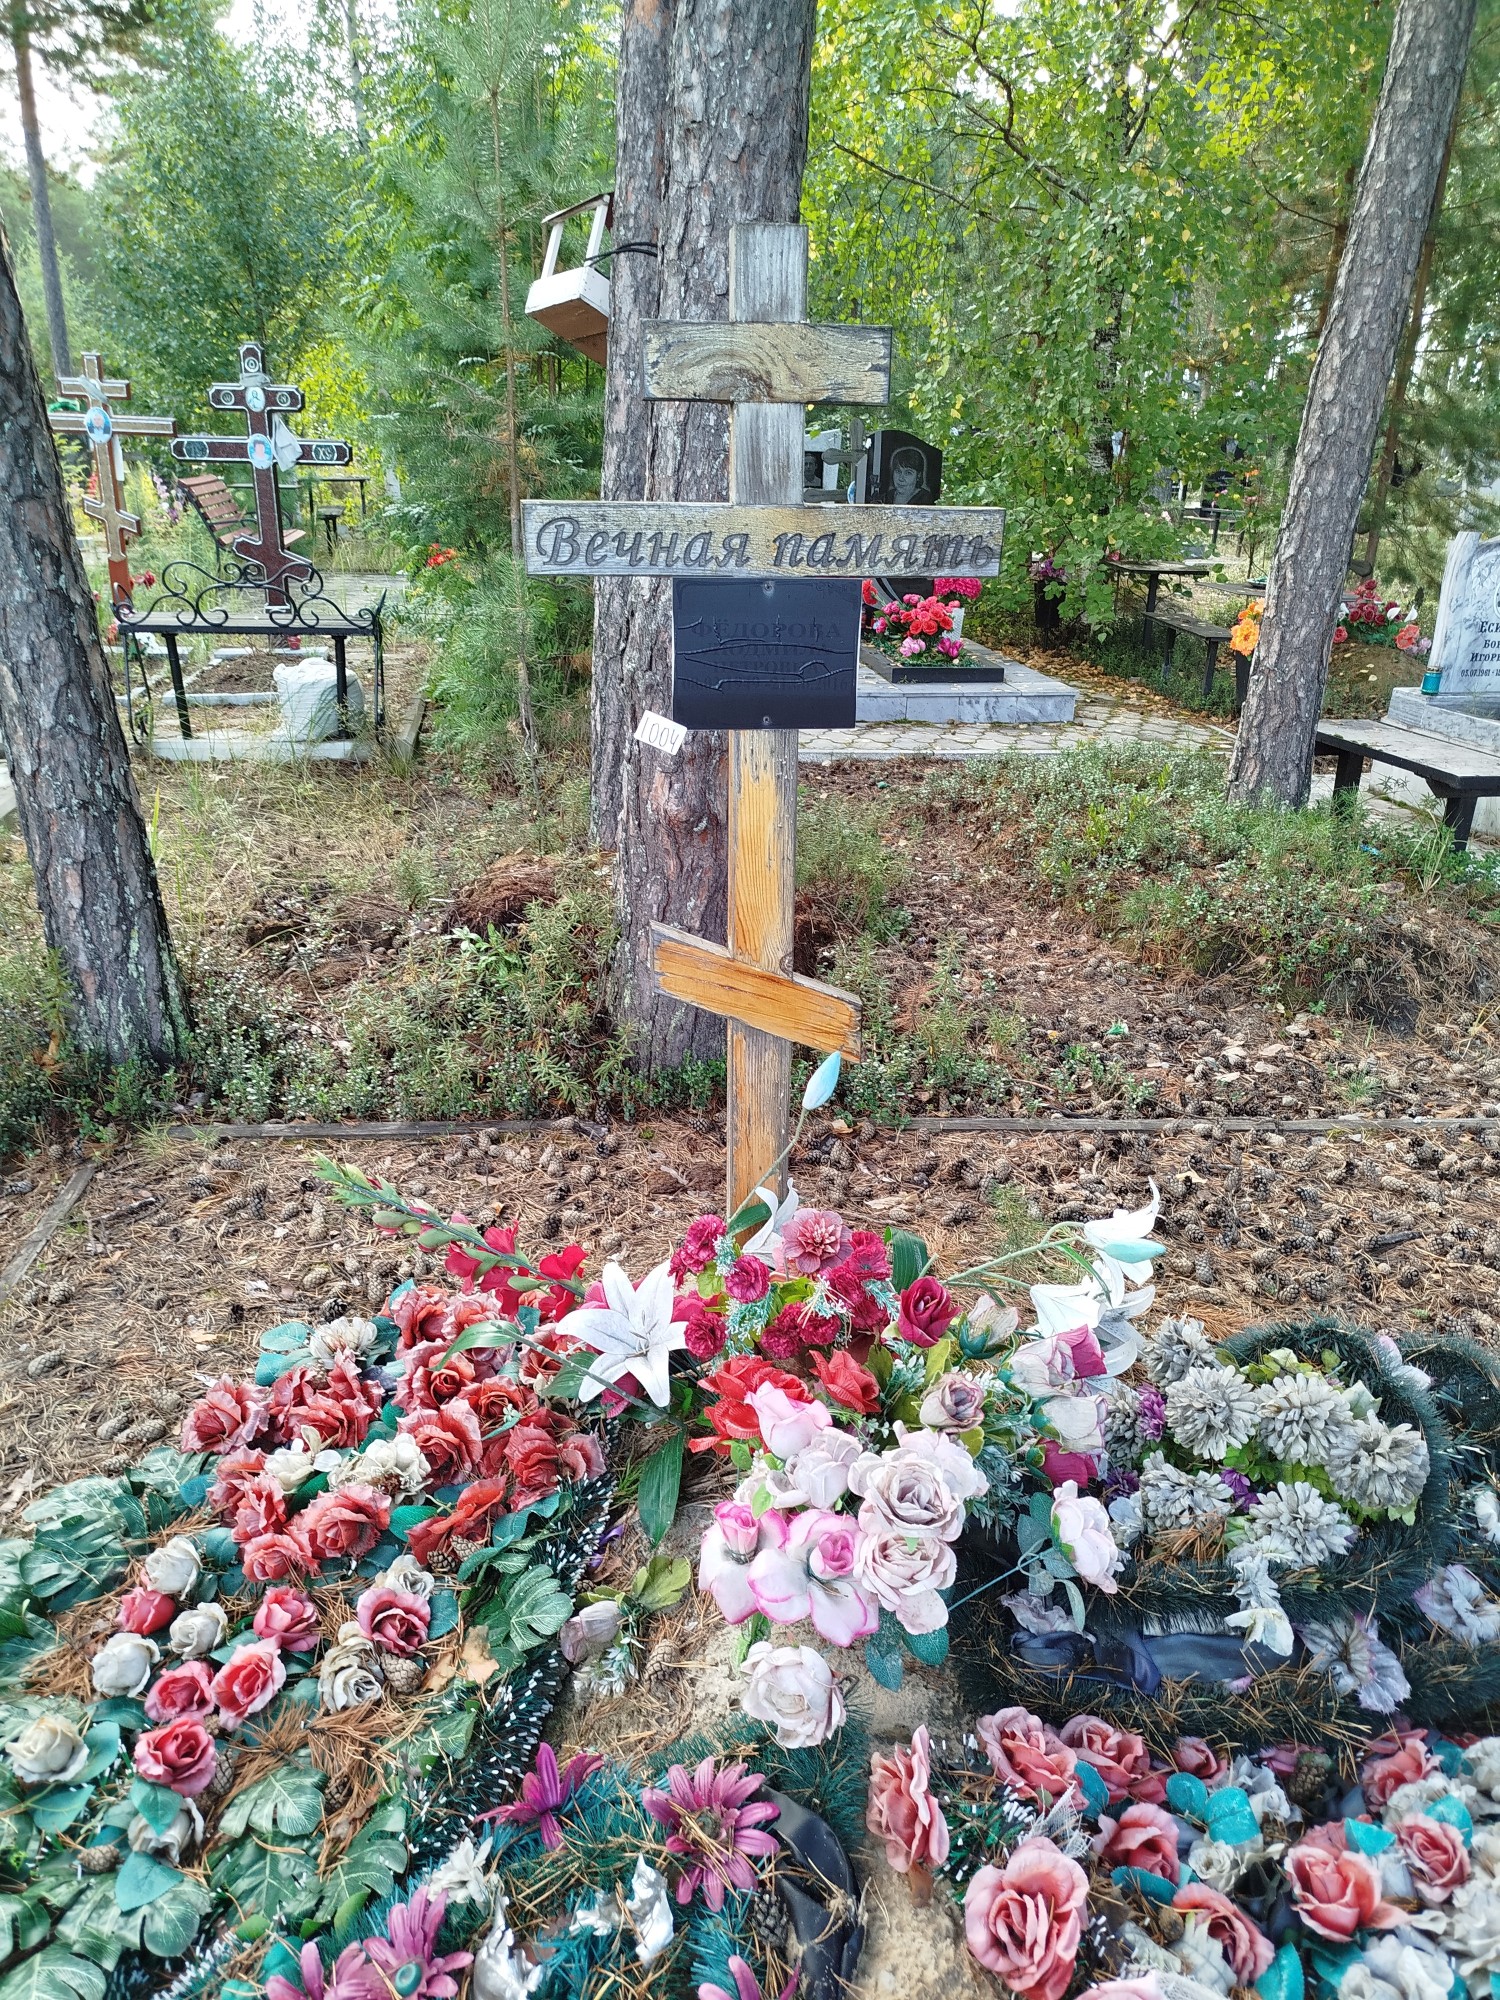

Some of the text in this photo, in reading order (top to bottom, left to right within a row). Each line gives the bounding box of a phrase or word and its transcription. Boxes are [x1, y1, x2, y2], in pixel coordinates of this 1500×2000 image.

[536, 516, 994, 569] Вечная память
[640, 717, 680, 753] 1004
